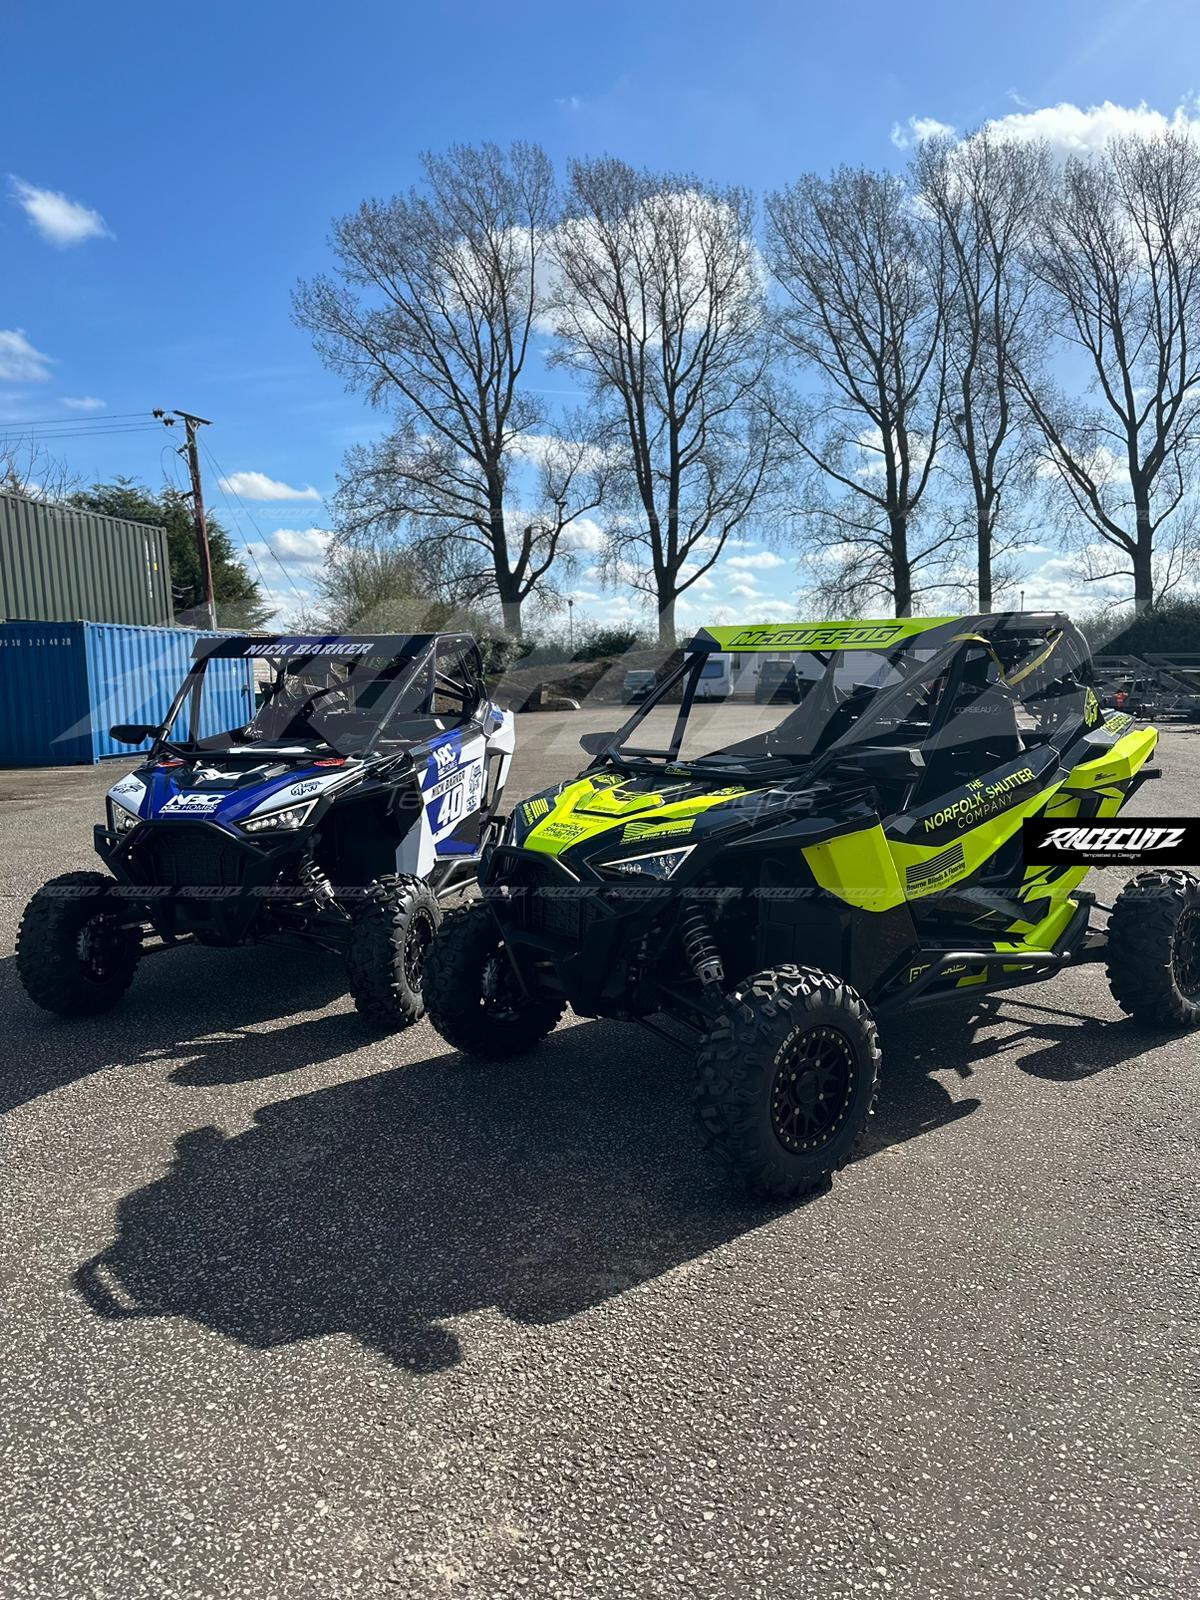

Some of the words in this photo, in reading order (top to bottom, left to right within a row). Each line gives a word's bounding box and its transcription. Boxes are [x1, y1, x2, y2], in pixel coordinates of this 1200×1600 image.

[728, 626, 904, 646] McGUFFOG
[243, 644, 294, 656] NICK
[292, 643, 375, 656] BARKER
[954, 706, 991, 714] CORBEAU
[965, 779, 984, 791] THE
[165, 794, 226, 806] NBC
[437, 783, 464, 826] 40
[924, 792, 985, 833] NORFOLK
[985, 767, 1036, 799] SHUTTER
[957, 792, 1014, 829] COMPANY
[906, 881, 927, 891] Bourne
[928, 874, 944, 885] Blinds
[949, 862, 966, 875] Flooring
